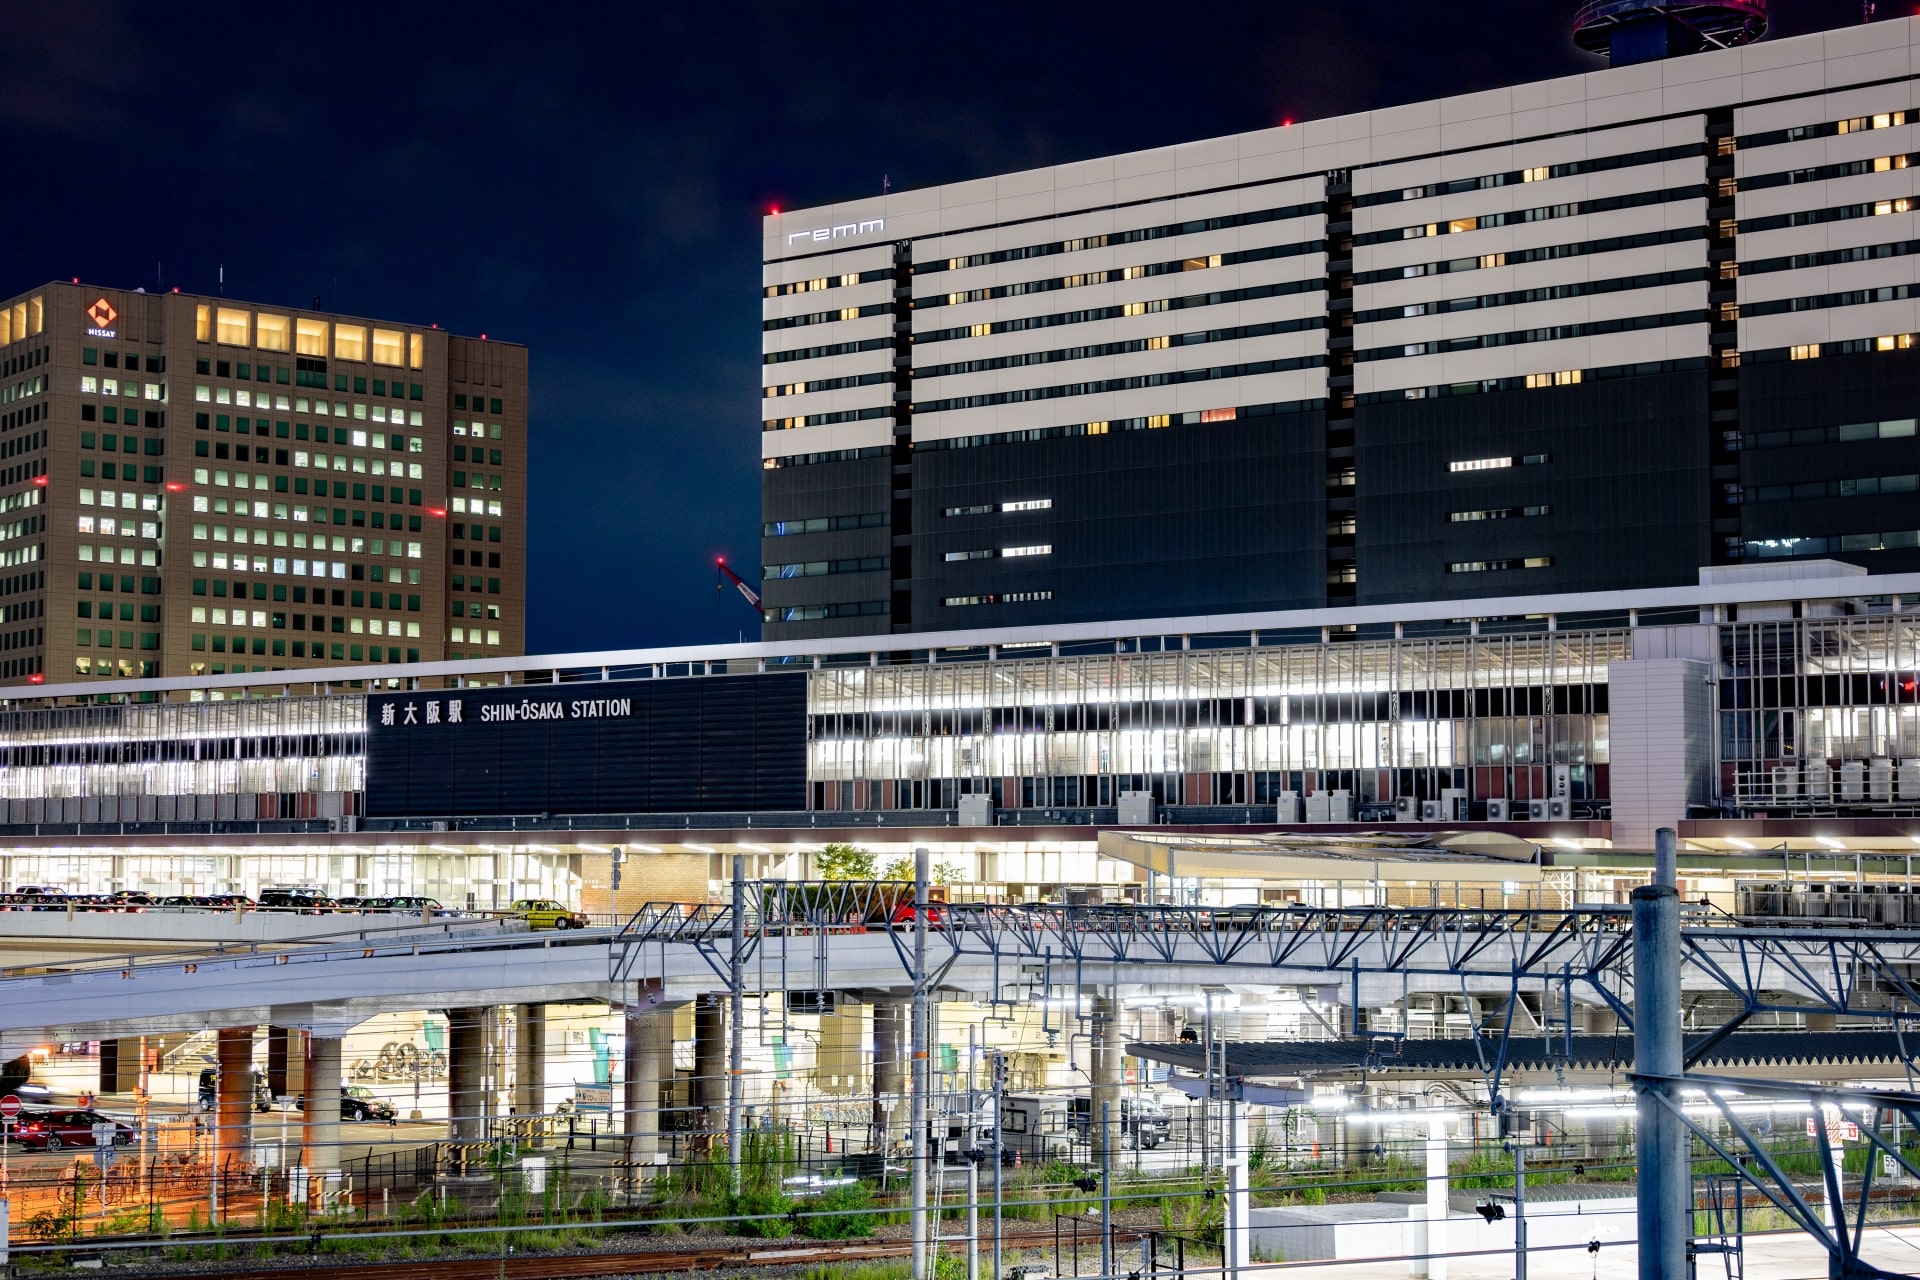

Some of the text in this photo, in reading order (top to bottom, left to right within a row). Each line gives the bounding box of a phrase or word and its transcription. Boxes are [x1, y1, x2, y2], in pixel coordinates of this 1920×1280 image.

[788, 218, 884, 246] remm
[88, 328, 115, 337] NISSAY
[381, 698, 631, 726] 新大阪駅 SHIN-ŌSAKA STATION
[1885, 1156, 1896, 1168] 55
